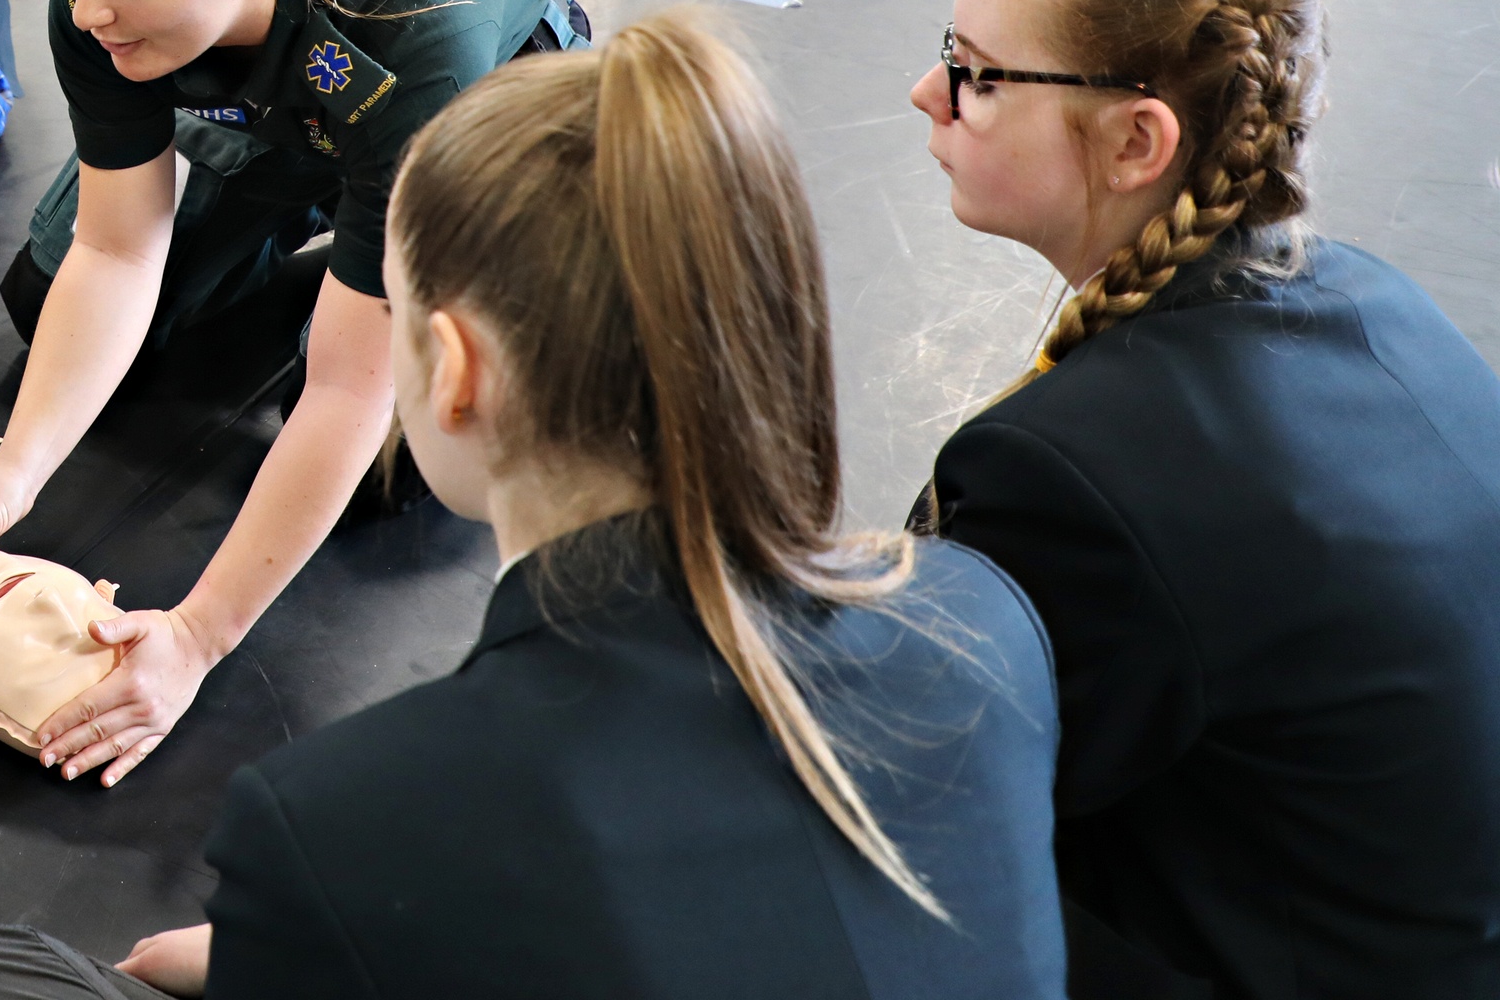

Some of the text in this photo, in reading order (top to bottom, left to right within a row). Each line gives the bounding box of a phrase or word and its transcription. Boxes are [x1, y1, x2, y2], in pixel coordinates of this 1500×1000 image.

[181, 107, 239, 121] NHS
[345, 73, 397, 124] ART PARAMEDIC
